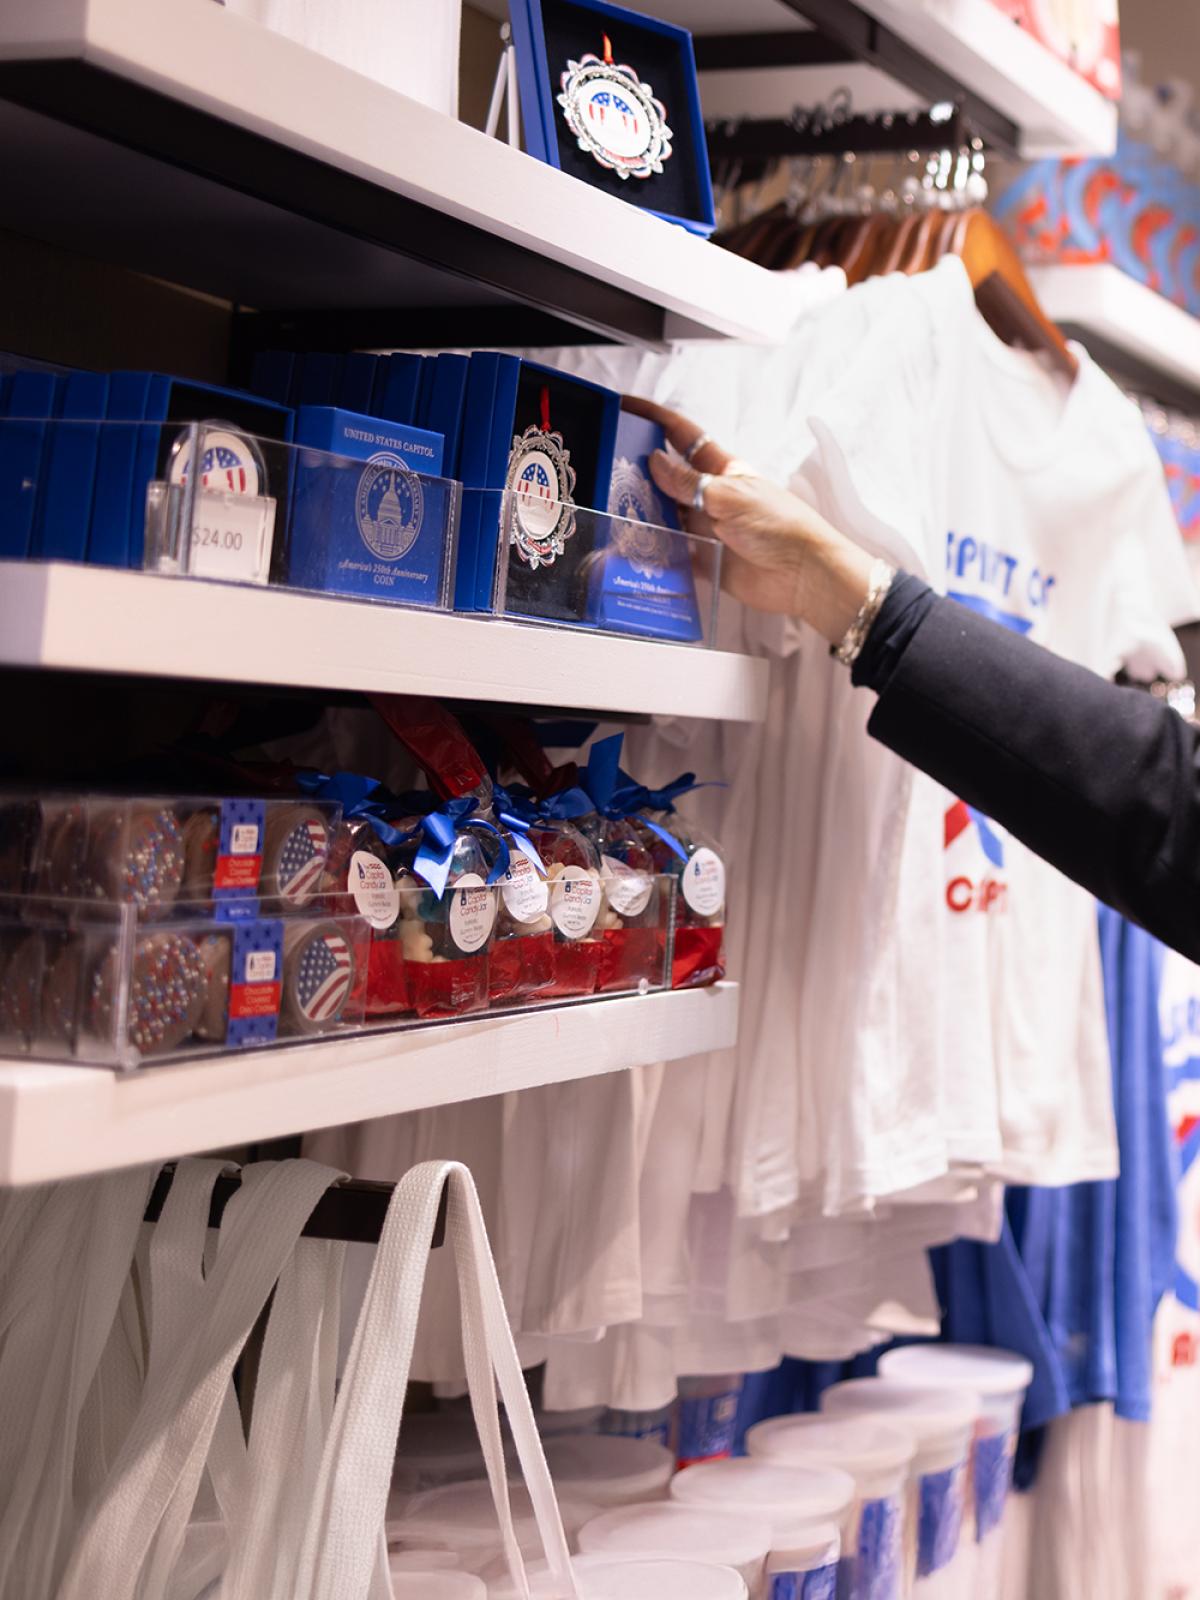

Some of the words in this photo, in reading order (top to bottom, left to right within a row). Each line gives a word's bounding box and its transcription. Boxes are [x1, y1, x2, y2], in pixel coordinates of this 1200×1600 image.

[344, 427, 374, 443] UNITED
[375, 435, 402, 450] STATES
[403, 441, 435, 458] CAPITOL
[192, 526, 243, 550] $24.00
[374, 574, 395, 586] COIN
